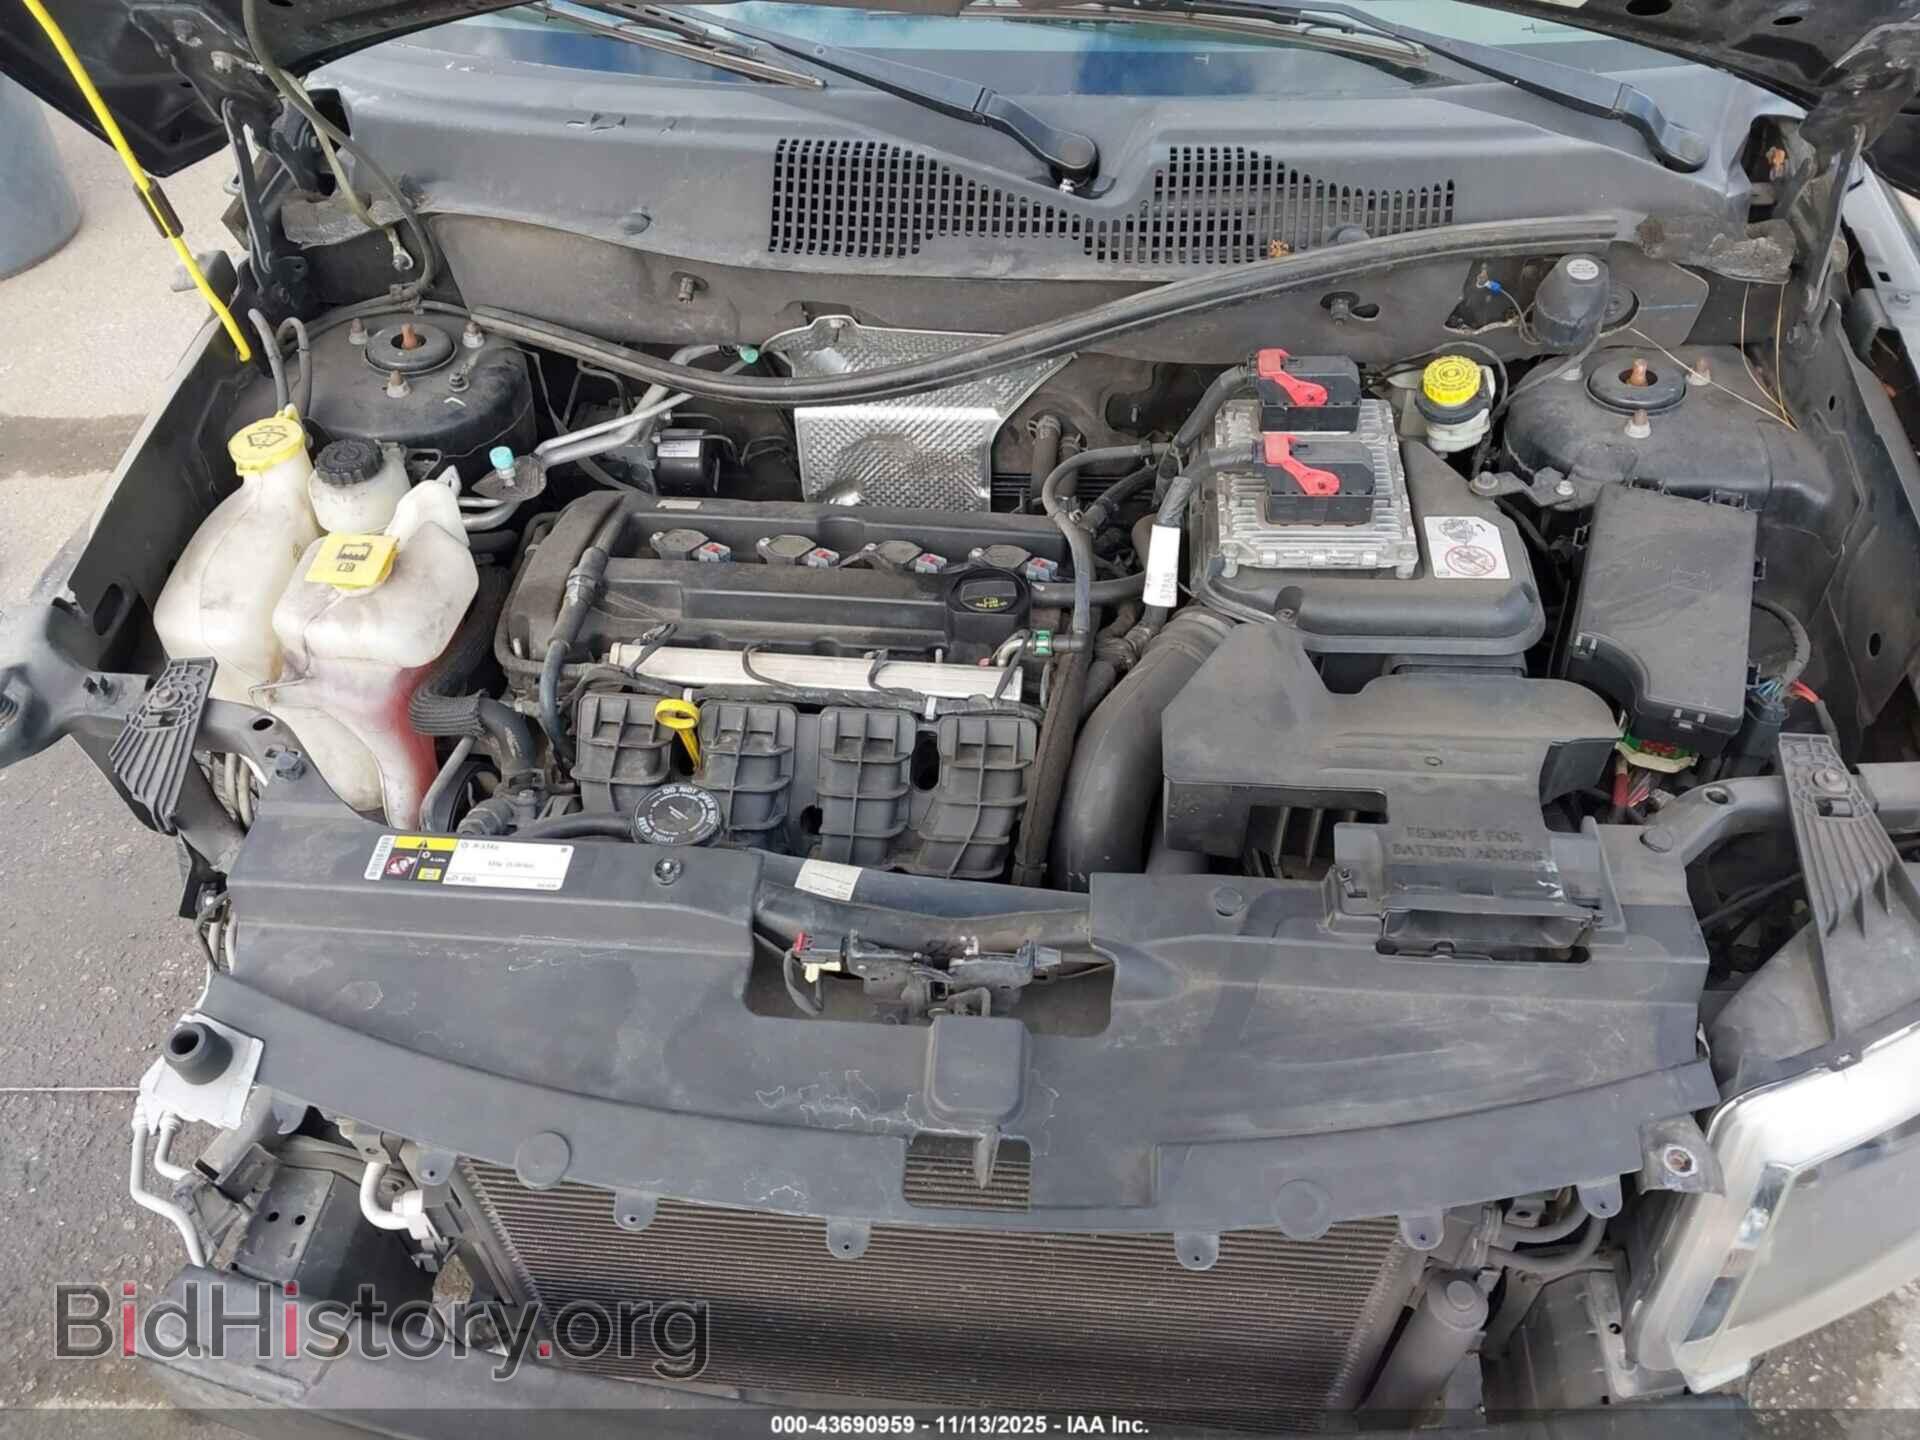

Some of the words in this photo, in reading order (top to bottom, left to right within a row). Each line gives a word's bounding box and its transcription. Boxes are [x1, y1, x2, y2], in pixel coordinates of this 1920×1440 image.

[662, 786, 676, 795] DO
[679, 785, 699, 795] NOT
[1406, 825, 1481, 842] REMOVE
[1486, 830, 1523, 844] FOR
[1391, 842, 1467, 859] BATTERY
